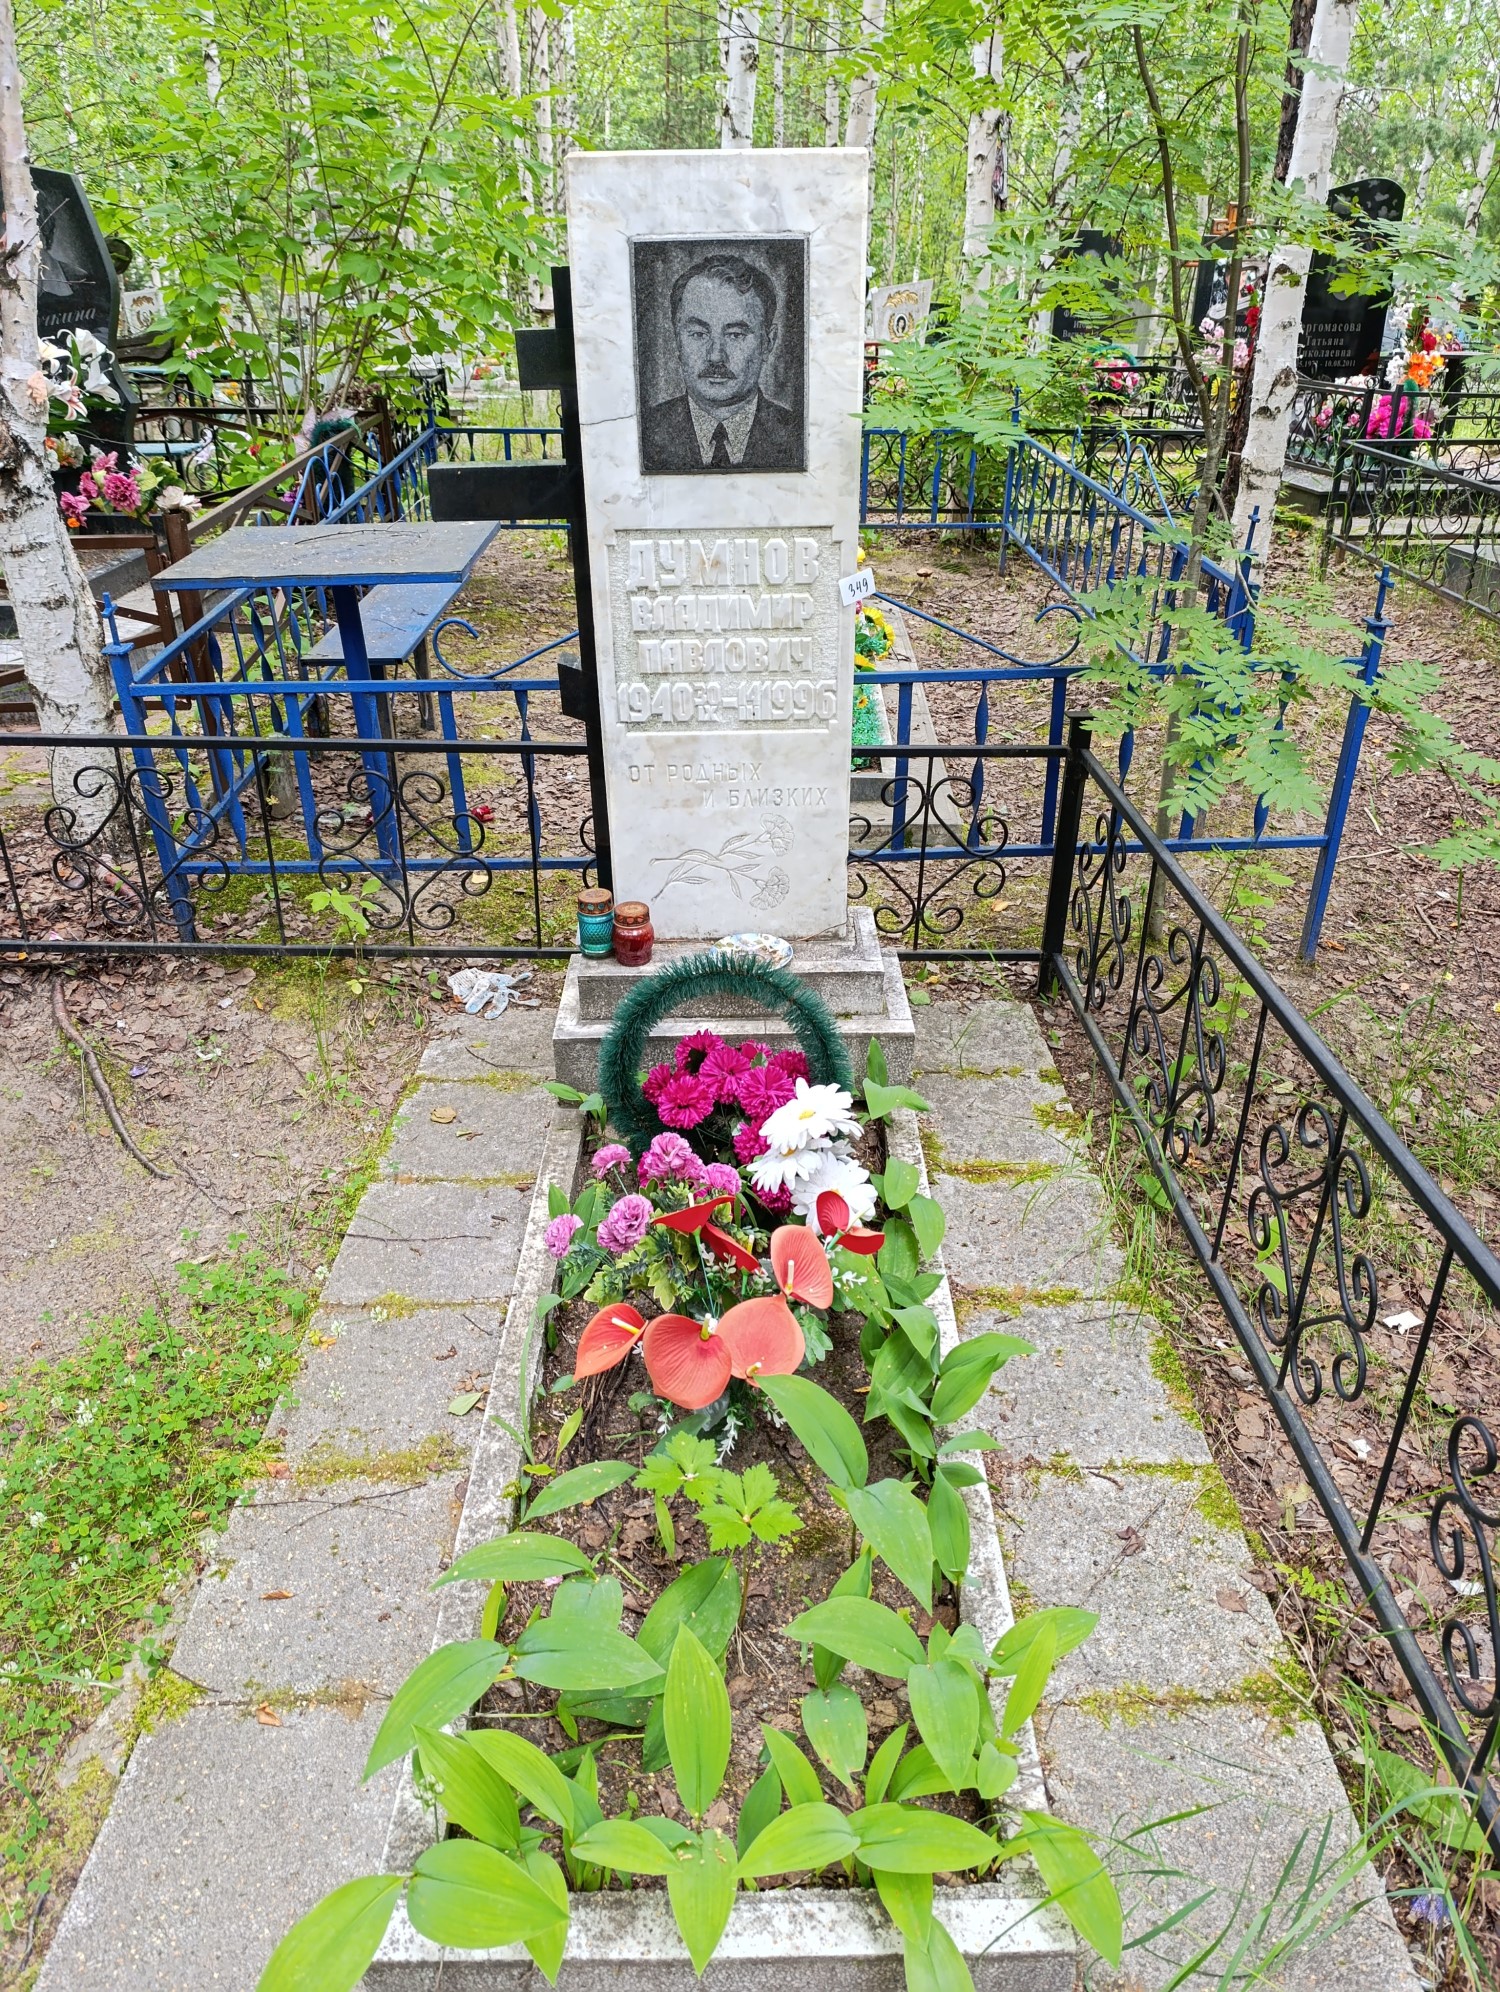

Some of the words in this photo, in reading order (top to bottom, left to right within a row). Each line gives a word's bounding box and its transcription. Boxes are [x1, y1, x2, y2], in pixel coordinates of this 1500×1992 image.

[1306, 336, 1344, 346] Татьяна
[625, 537, 820, 592] ДУМНОВ
[848, 577, 868, 597] 349
[630, 592, 815, 634] ВЛАДИМИР
[637, 637, 813, 674] ПАВЛОВИЧ
[628, 765, 655, 783] ОТ
[667, 763, 763, 784] РОДНЫХ
[703, 788, 715, 808] И
[728, 787, 829, 809] БЛИЗКИХ
